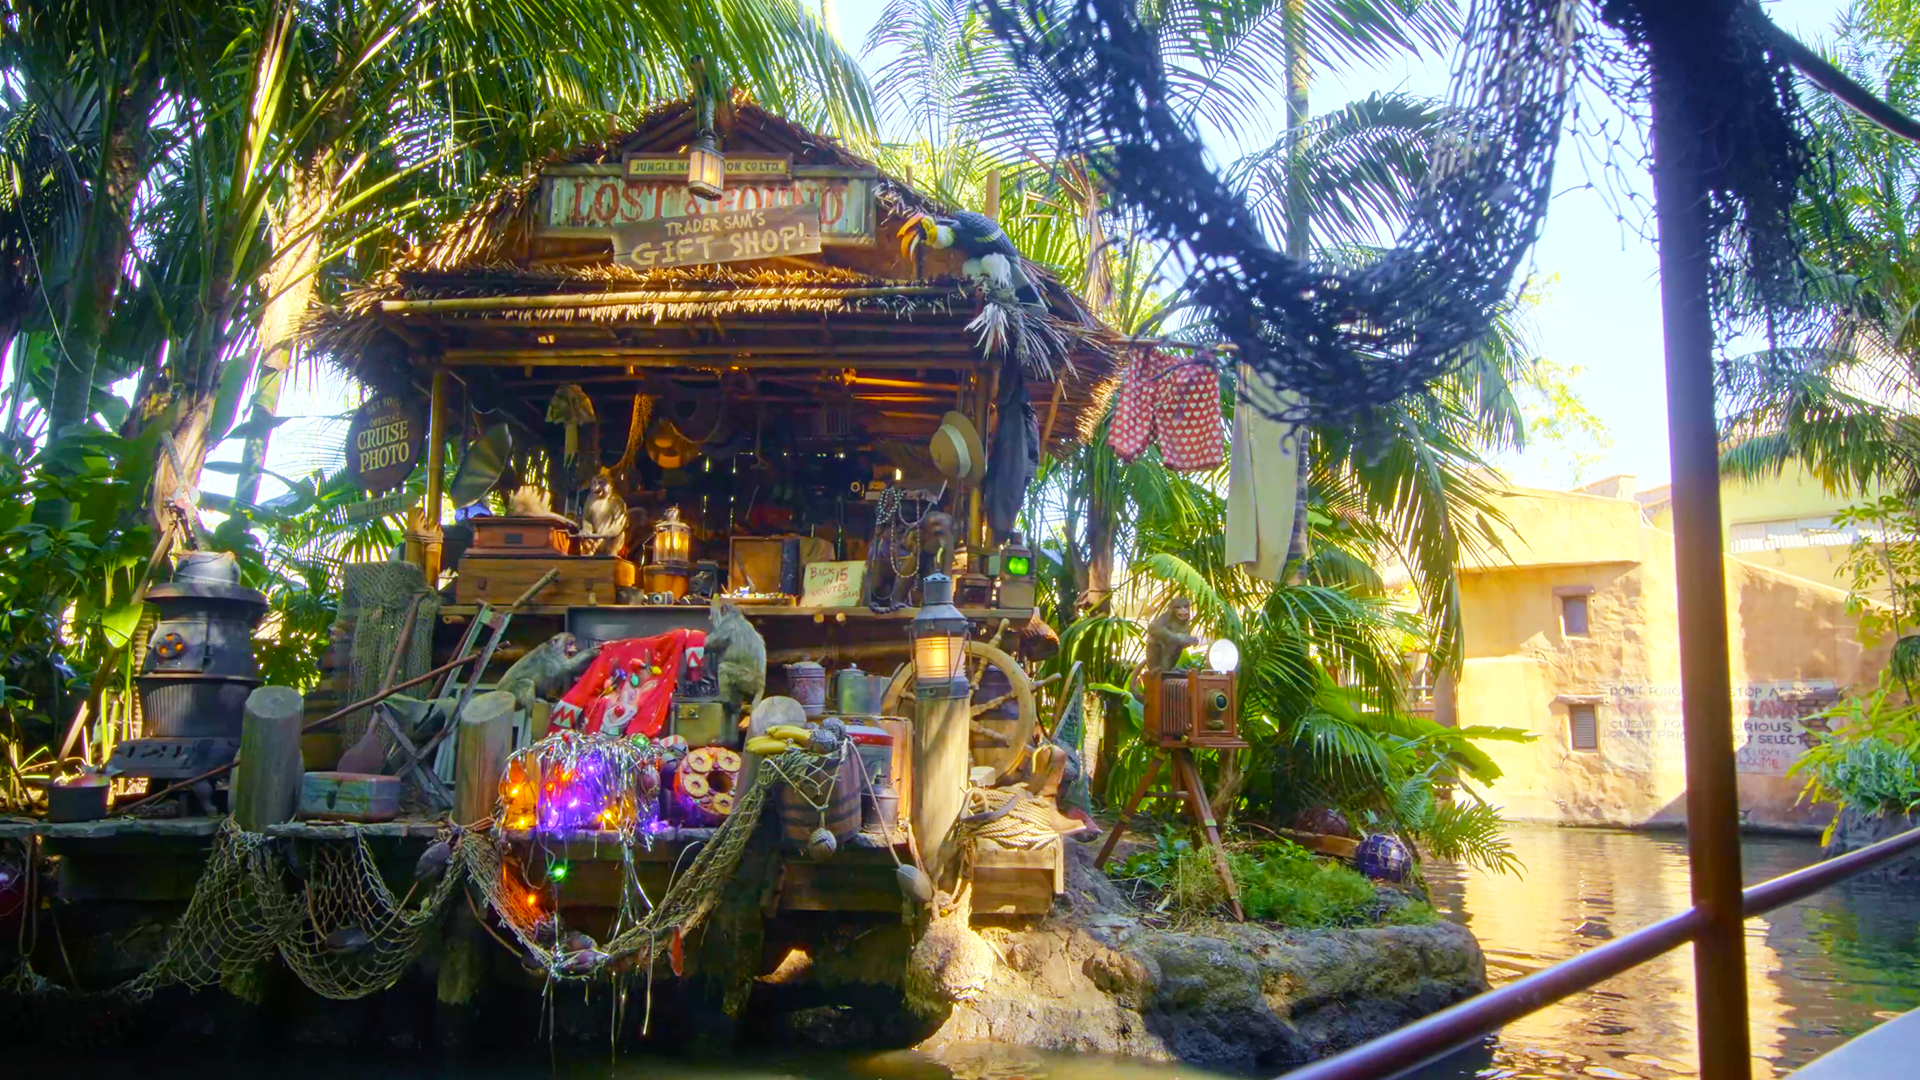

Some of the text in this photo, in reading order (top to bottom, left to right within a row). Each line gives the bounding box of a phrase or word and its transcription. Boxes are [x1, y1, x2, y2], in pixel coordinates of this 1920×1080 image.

[635, 162, 674, 172] JUNGLE
[572, 182, 667, 222] LOST
[683, 192, 703, 215] &
[665, 209, 766, 236] TRADER SAM'S
[631, 222, 805, 266] GIFT SHOP!
[357, 420, 409, 450] CRUISE
[359, 441, 410, 473] PHOTO
[810, 567, 848, 582] BACK 15
[823, 576, 833, 585] IN
[811, 583, 849, 597] MINUTES
[1733, 721, 1792, 733] URIOUS
